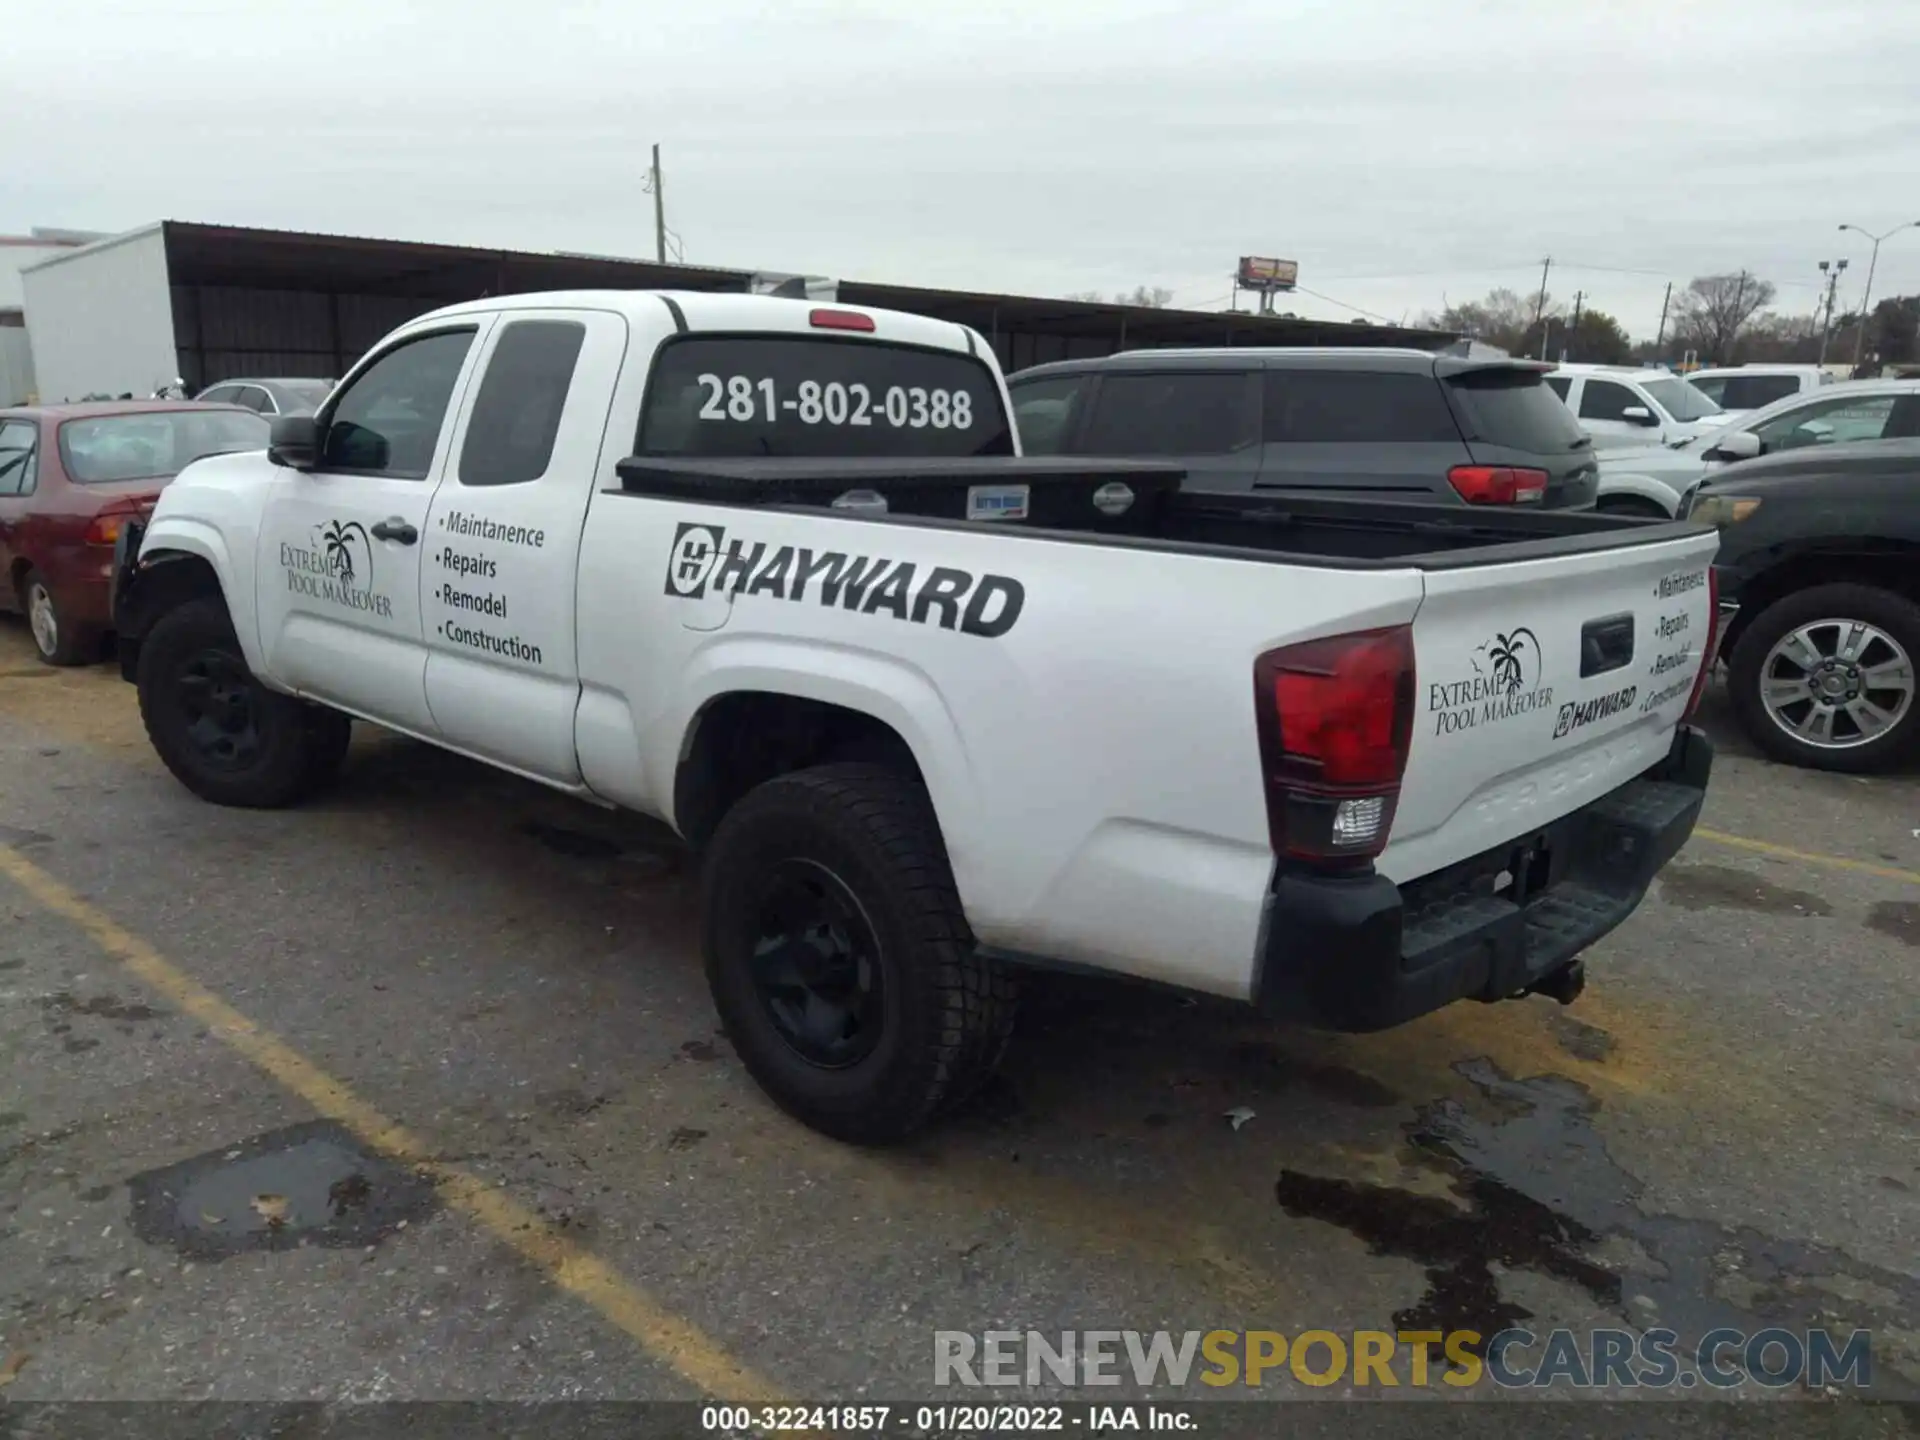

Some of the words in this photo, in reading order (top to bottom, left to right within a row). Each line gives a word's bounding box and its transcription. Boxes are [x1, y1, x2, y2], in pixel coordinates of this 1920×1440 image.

[697, 374, 973, 430] 281-802-0388
[446, 510, 545, 548] Maintanence
[280, 542, 336, 578] EXTREME
[443, 548, 497, 578] Repairs
[287, 569, 321, 599] POOL
[322, 577, 393, 619] MAKEOVER
[443, 584, 507, 618] Remodel
[713, 538, 1026, 640] HAYWARD
[445, 619, 542, 664] Construction
[1428, 672, 1504, 712] EXTREME
[1435, 704, 1479, 737] POOL
[1480, 687, 1553, 724] MAKEOVER
[1571, 685, 1637, 729] HAYWARD
